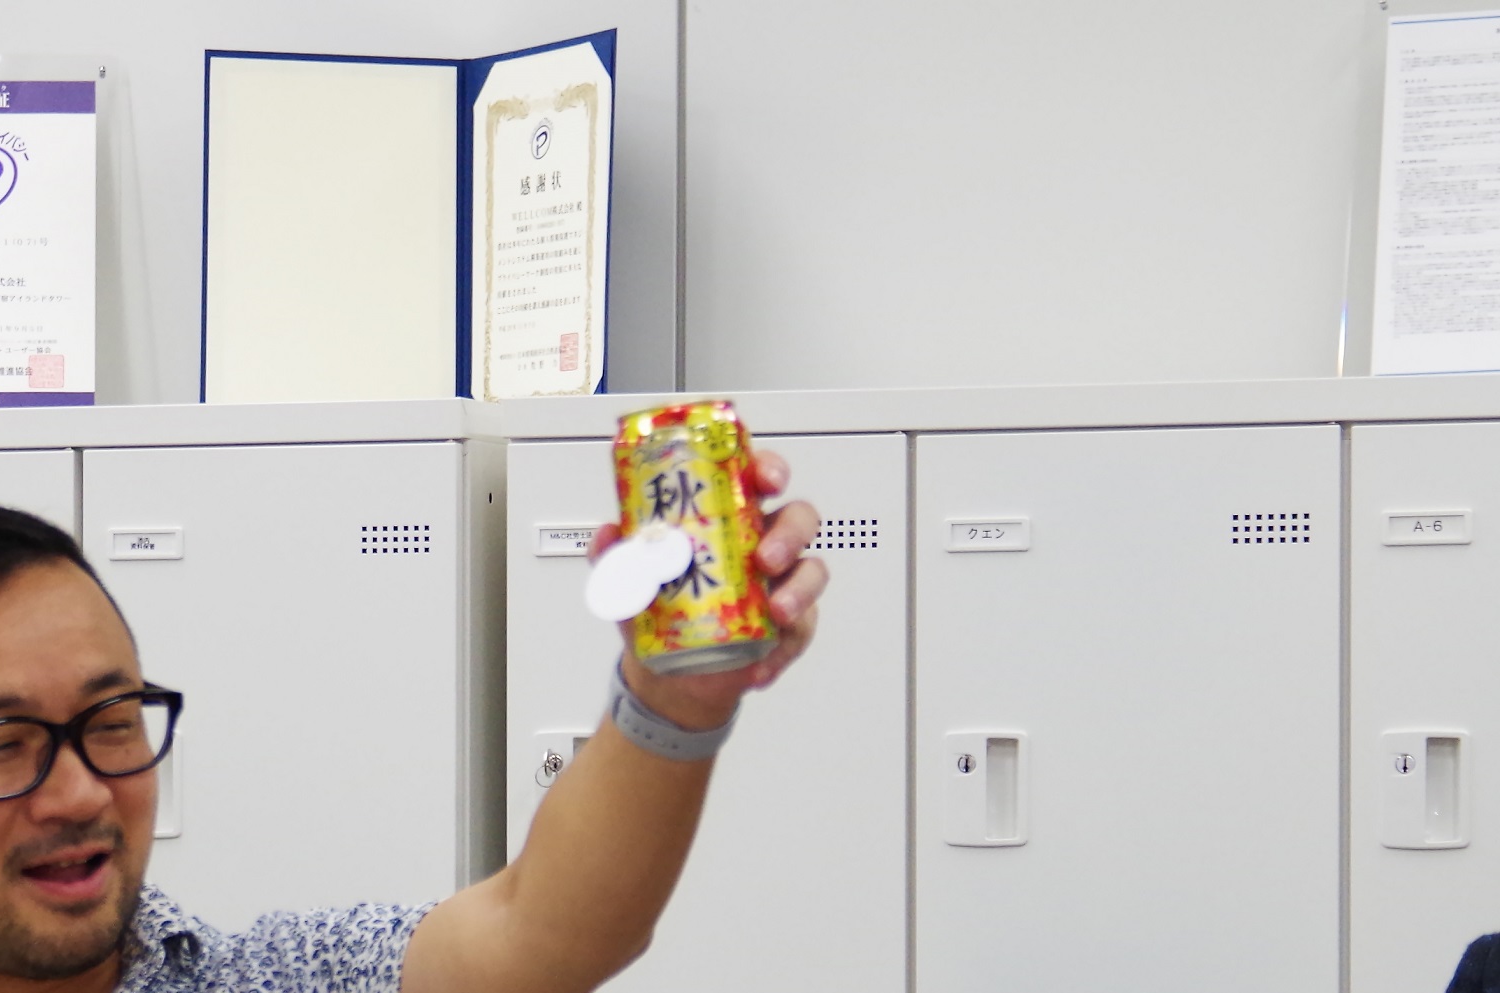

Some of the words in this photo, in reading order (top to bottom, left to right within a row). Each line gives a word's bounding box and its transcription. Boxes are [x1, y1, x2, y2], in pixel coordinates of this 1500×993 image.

[520, 170, 562, 196] 感謝状
[1413, 520, 1443, 532] A-6
[968, 528, 1005, 540] クエン
